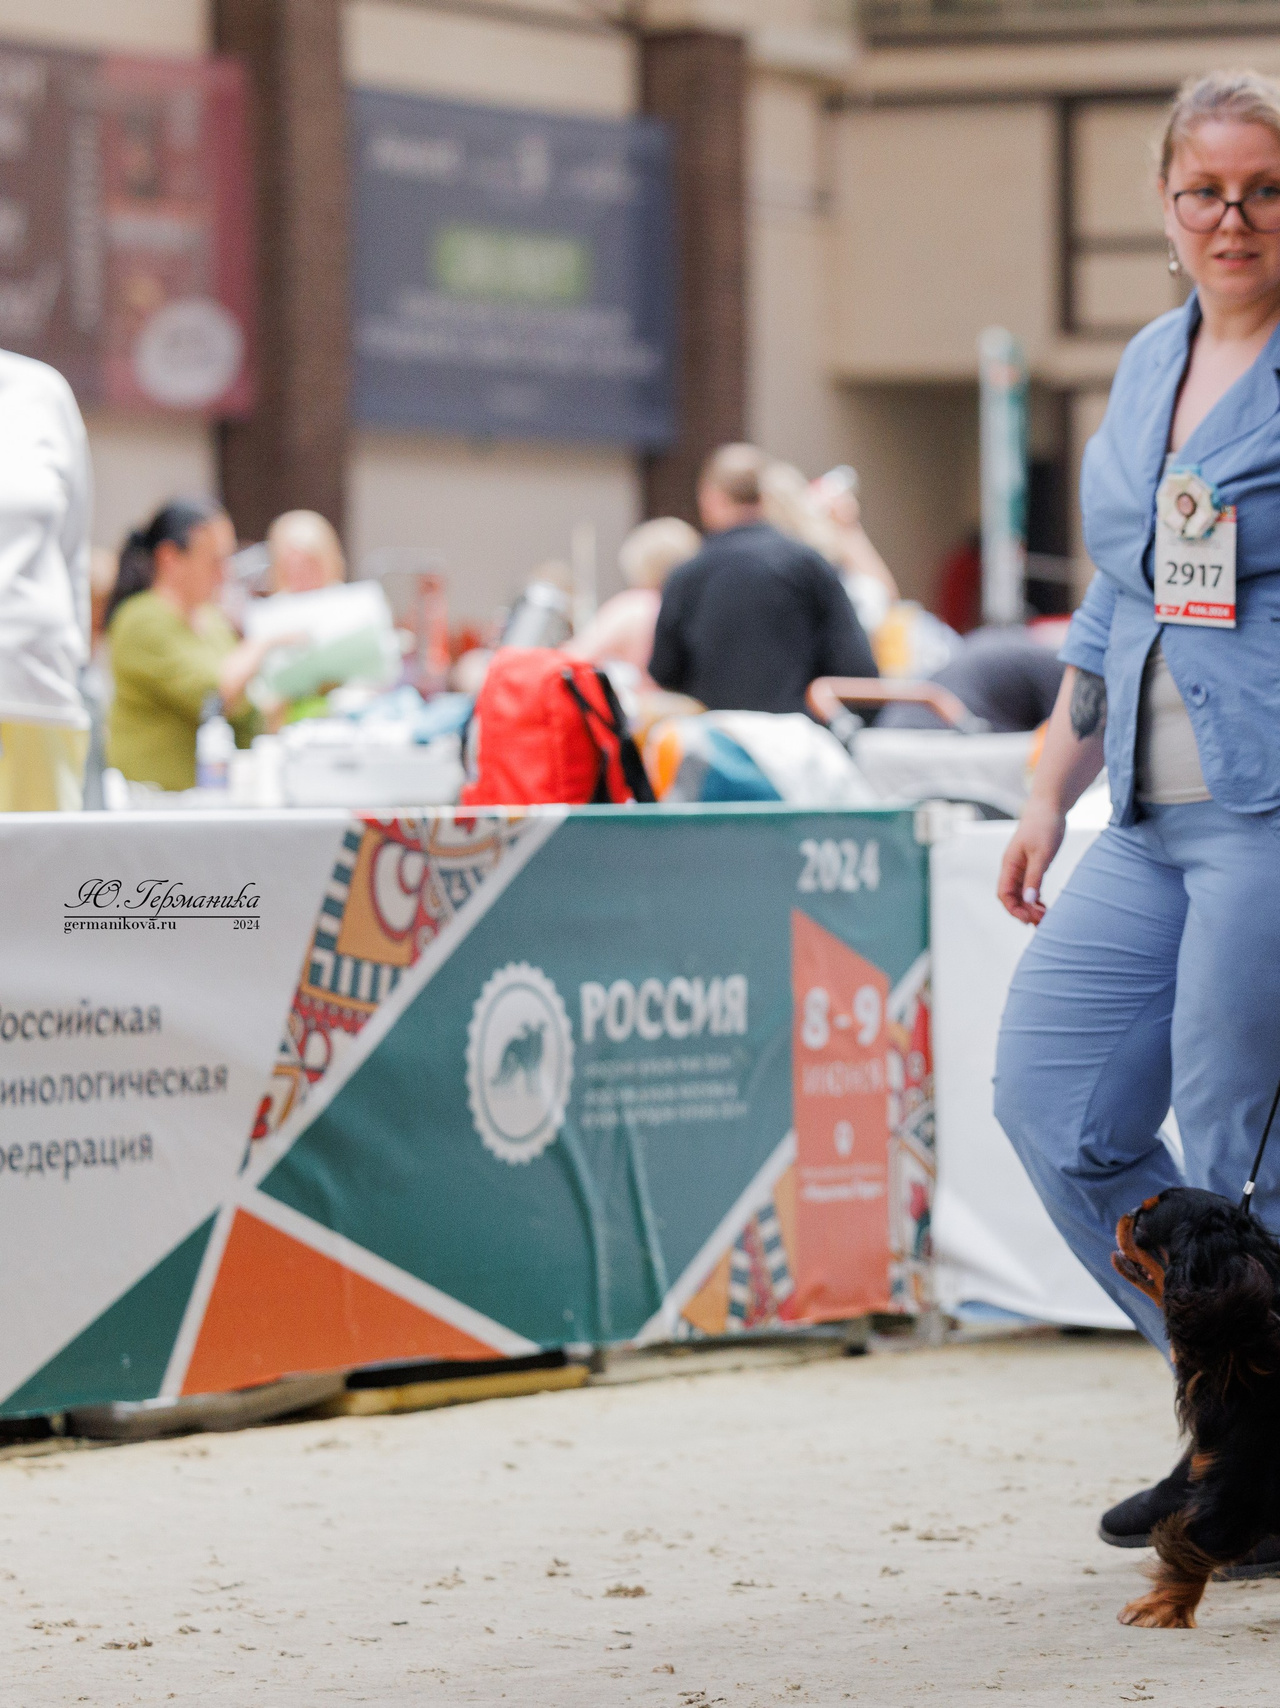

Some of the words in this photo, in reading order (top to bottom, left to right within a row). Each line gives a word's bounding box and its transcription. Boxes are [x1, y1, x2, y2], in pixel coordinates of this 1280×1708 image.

[1166, 561, 1223, 588] 2917
[799, 839, 881, 893] 2024
[0, 999, 162, 1041] оссийская
[580, 974, 748, 1044] РОССИЯ
[0, 1131, 153, 1180] едерация
